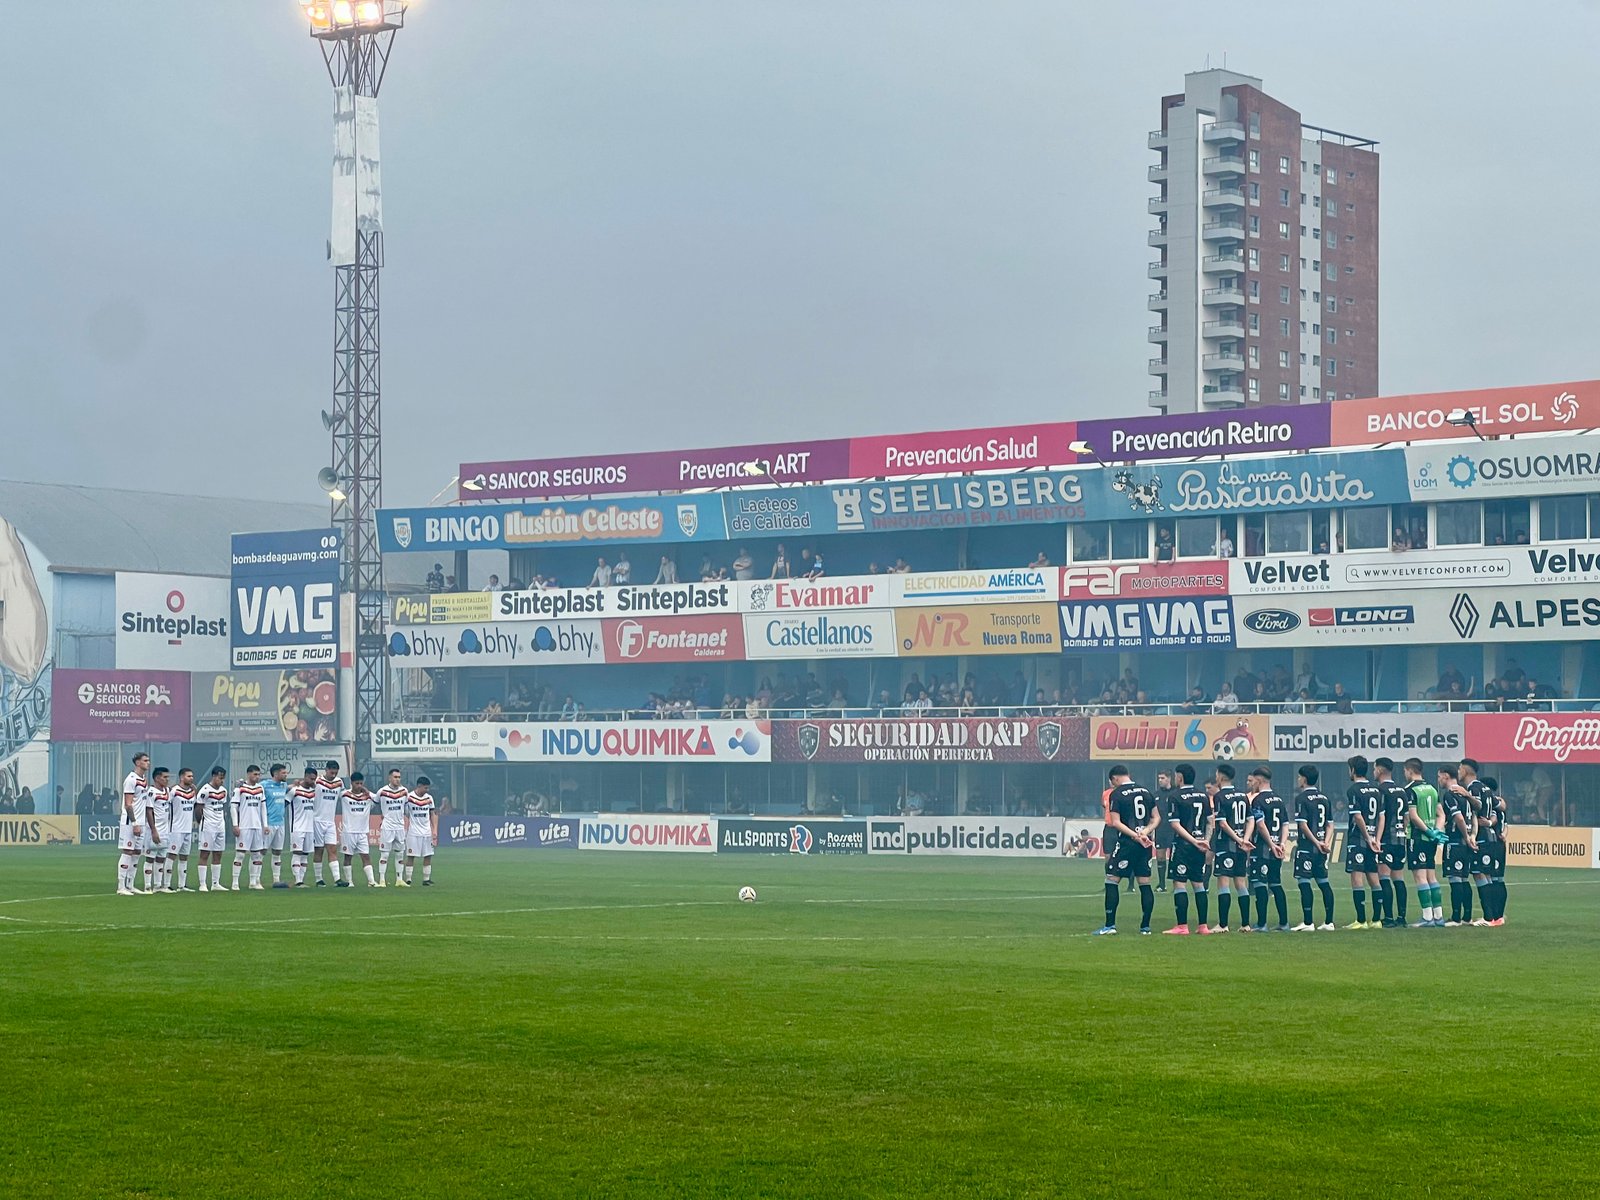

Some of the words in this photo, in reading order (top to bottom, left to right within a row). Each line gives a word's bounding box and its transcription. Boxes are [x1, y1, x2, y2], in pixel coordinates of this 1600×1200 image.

[1367, 409, 1445, 433] BANCO
[1498, 402, 1544, 422] SOL
[1111, 426, 1224, 453] Prevención
[1227, 421, 1292, 445] Retiro
[885, 445, 985, 468] Prevención
[986, 436, 1038, 461] Salud
[773, 452, 811, 476] ART
[1478, 452, 1600, 480] OSUOMR
[488, 467, 550, 490] SANCOR
[553, 464, 627, 487] SEGUROS
[1248, 471, 1292, 483] vaca
[1413, 478, 1438, 488] UOM
[868, 474, 1083, 514] SEELISBERG
[1169, 469, 1375, 513] Pascualita
[739, 496, 798, 514] Lacteos
[971, 510, 991, 524] EN
[996, 504, 1086, 522] ALIMENTOS
[425, 515, 499, 544] BINGO
[506, 507, 578, 536] Ilusión
[582, 505, 661, 532] Celeste
[732, 515, 751, 532] de
[754, 511, 811, 531] Calidad
[233, 549, 338, 565] bombasdeaguavmg.com
[904, 575, 986, 591] ELECTRICIDAD
[988, 570, 1044, 588] AMÉRICA
[1131, 575, 1224, 590] MOTOPARTES
[1244, 560, 1330, 584] Velvet
[1363, 565, 1505, 578] WWW.VELVETCONFORT.COM
[500, 589, 604, 618] Sinteplast
[617, 584, 728, 616] Sinteplast
[776, 583, 874, 608] Evamar
[237, 583, 333, 635] VMG
[395, 597, 428, 623] Pipu
[991, 612, 1041, 627] Transporte
[1146, 600, 1230, 636] VMG
[1340, 609, 1408, 623] LONG
[1489, 598, 1600, 629] ALPES
[121, 611, 227, 637] Sinteplast
[766, 617, 873, 646] Castellanos
[1061, 603, 1141, 639] VMG
[1255, 612, 1289, 631] Ford
[647, 629, 727, 651] Fontanet
[983, 632, 1019, 646] Nueva
[1021, 630, 1053, 646] Roma
[1063, 638, 1099, 647] BOMBAS
[1102, 639, 1115, 647] DE
[1118, 638, 1142, 646] AGUA
[1150, 636, 1186, 645] BOMBAS
[1190, 636, 1202, 644] DE
[1206, 635, 1231, 643] AGUA
[236, 650, 277, 662] BOMBAS
[282, 649, 297, 660] DE
[302, 648, 333, 660] AGUA
[694, 648, 725, 656] Calderas
[96, 684, 140, 693] SANCOR
[96, 695, 141, 704] SEGUROS
[212, 675, 261, 708] Pipu
[90, 709, 130, 718] Respuestas
[375, 728, 456, 745] SPORTFIELD
[542, 725, 716, 756] INDUQUIMIKA
[829, 723, 969, 747] SEGURIDAD
[976, 721, 1029, 746] O&P
[1095, 721, 1178, 751] Quini
[1184, 719, 1207, 752] 6
[1309, 728, 1458, 753] publicidades
[259, 748, 298, 761] CRECER
[864, 746, 930, 760] OPERACIÓN
[933, 749, 993, 760] PERFECTA
[1134, 796, 1146, 819] 6
[1193, 803, 1203, 827] 7
[1232, 801, 1247, 824] 10
[1317, 804, 1326, 827] 3
[1368, 797, 1378, 819] 9
[1397, 798, 1404, 820] 2
[1426, 795, 1432, 818] 1
[450, 820, 481, 839] vita
[495, 822, 526, 840] vita
[1272, 808, 1280, 831] 5
[539, 823, 570, 841] vita
[582, 823, 712, 846] INDUQUIMIKA
[827, 832, 863, 843] Rossetti
[907, 826, 1057, 853] publicidades
[1508, 843, 1549, 855] NUESTRA
[1551, 843, 1585, 856] CIUDAD
